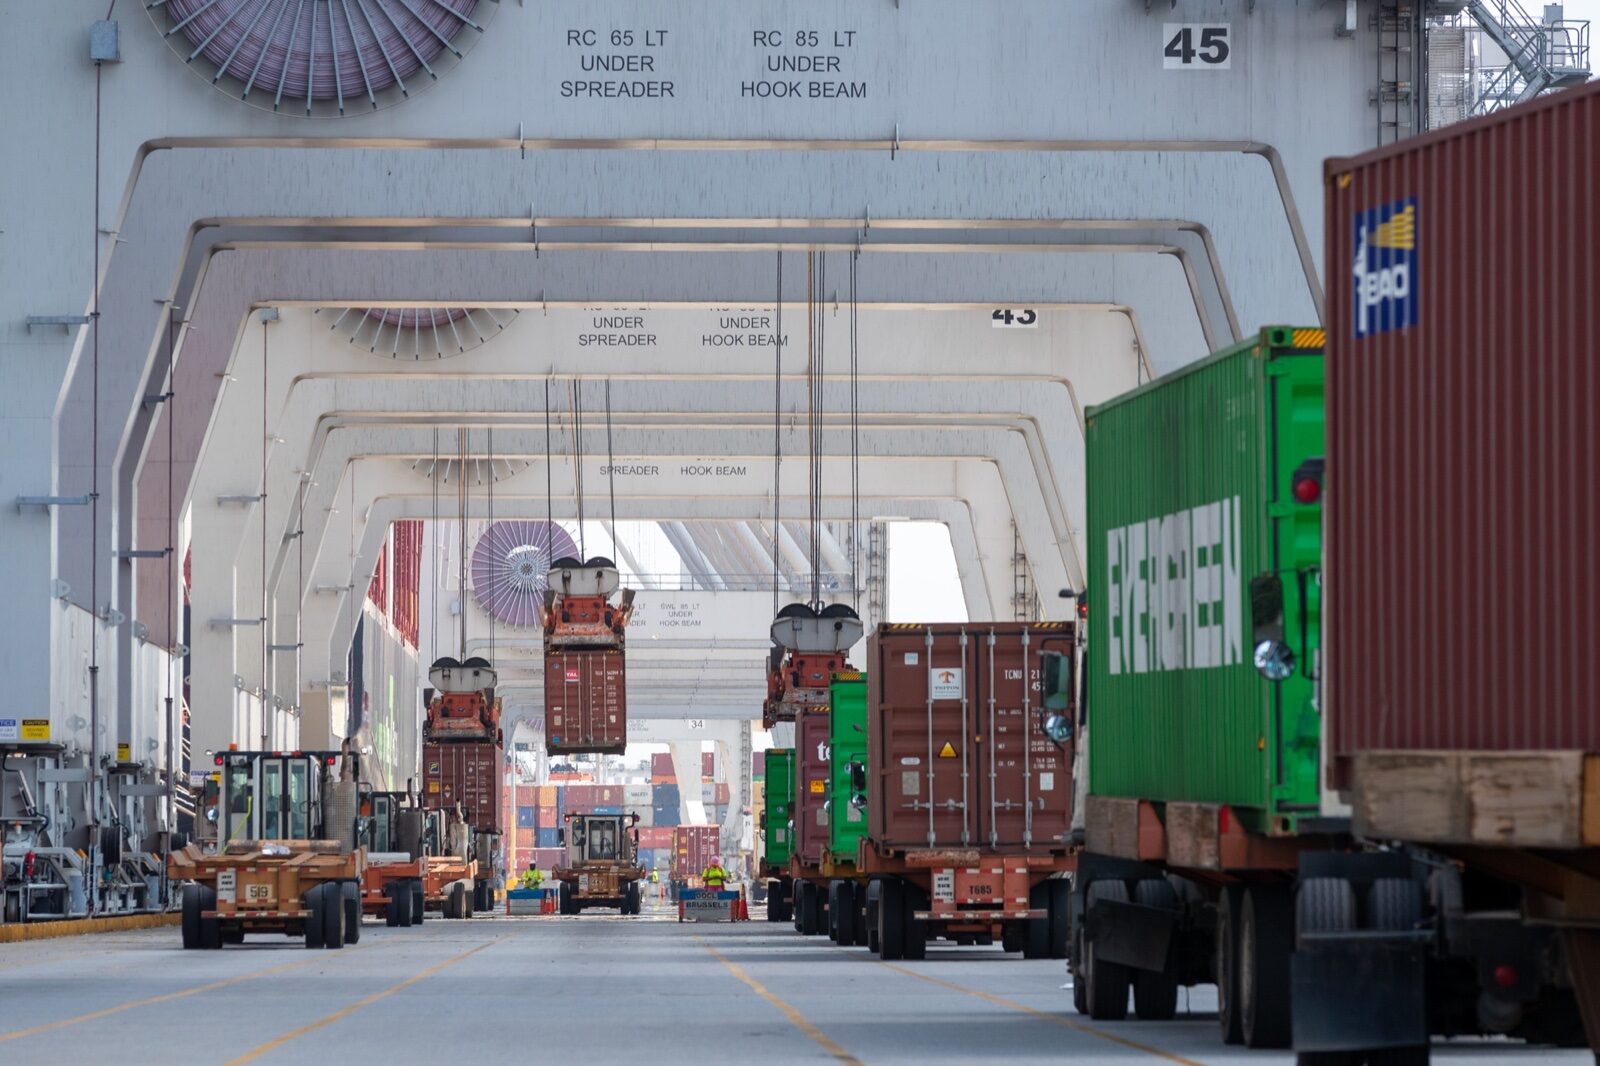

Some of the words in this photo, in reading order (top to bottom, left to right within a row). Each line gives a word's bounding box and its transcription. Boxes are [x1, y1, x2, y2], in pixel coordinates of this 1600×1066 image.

[567, 30, 597, 46] RC
[610, 30, 634, 46] 65
[645, 30, 669, 46] LT
[753, 31, 782, 47] RC
[795, 31, 819, 47] 85
[834, 31, 857, 47] LT
[1164, 28, 1229, 64] 45
[581, 55, 655, 72] UNDER
[767, 56, 841, 73] UNDER
[560, 81, 675, 98] SPREADER
[741, 81, 802, 98] HOOK
[808, 81, 867, 98] BEAM
[593, 316, 644, 329] UNDER
[719, 317, 770, 329] UNDER
[578, 334, 657, 347] SPREADER
[702, 334, 744, 347] HOOK
[748, 334, 788, 347] BEAM
[599, 465, 659, 476] SPREADER
[680, 466, 713, 476] HOOK
[715, 466, 747, 476] BEAM
[668, 610, 693, 618] UNDER
[1004, 669, 1023, 680] TCNU
[691, 719, 703, 729] 34
[250, 886, 269, 898] 519
